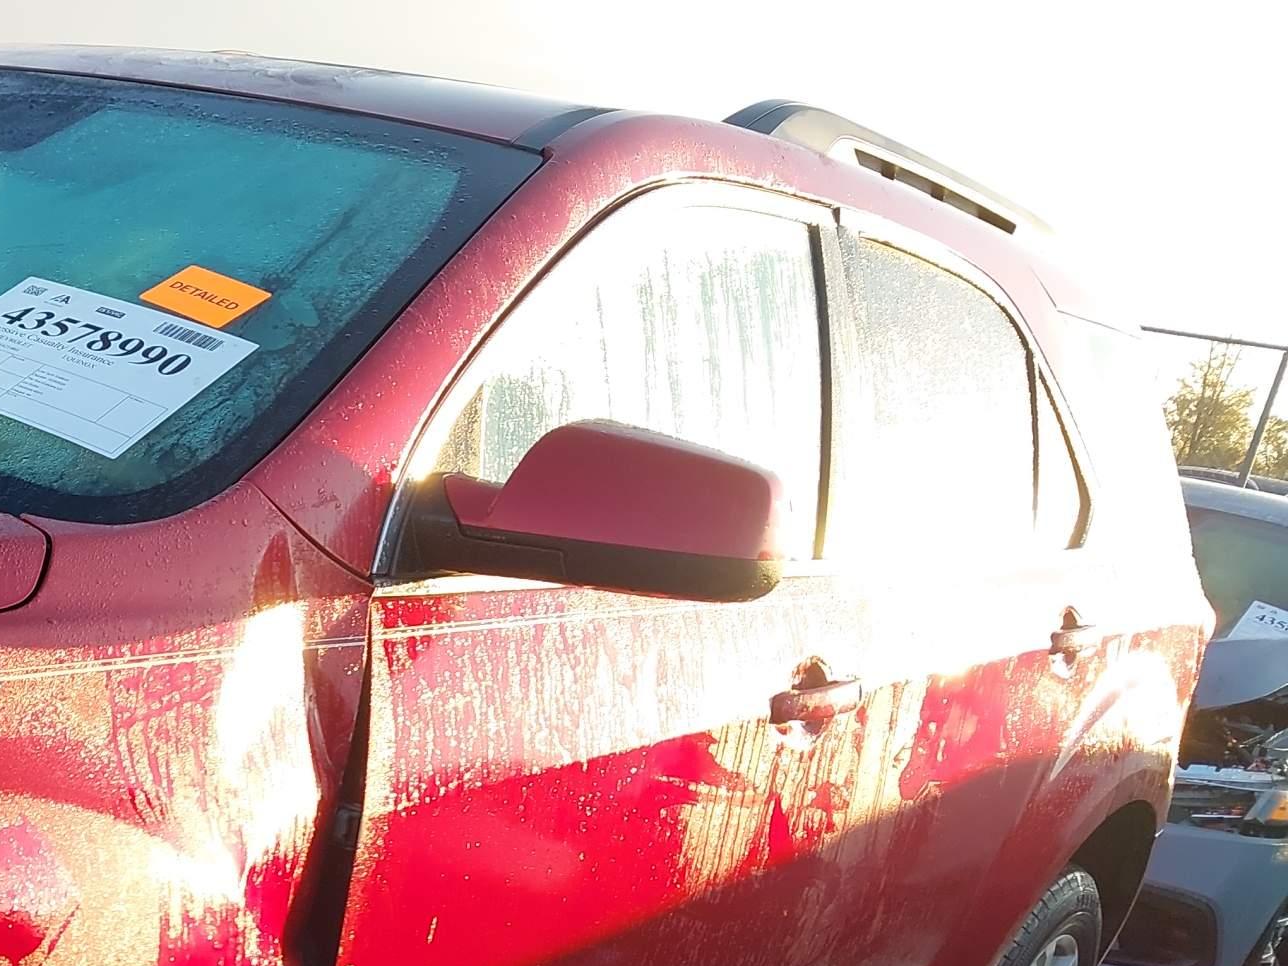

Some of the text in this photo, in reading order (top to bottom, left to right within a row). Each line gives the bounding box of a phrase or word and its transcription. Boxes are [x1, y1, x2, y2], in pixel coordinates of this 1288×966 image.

[169, 281, 240, 311] DETAILED
[1, 307, 192, 376] 43578990
[27, 334, 67, 351] Casualty
[68, 346, 114, 366] Insurance
[1255, 614, 1288, 633] 435
